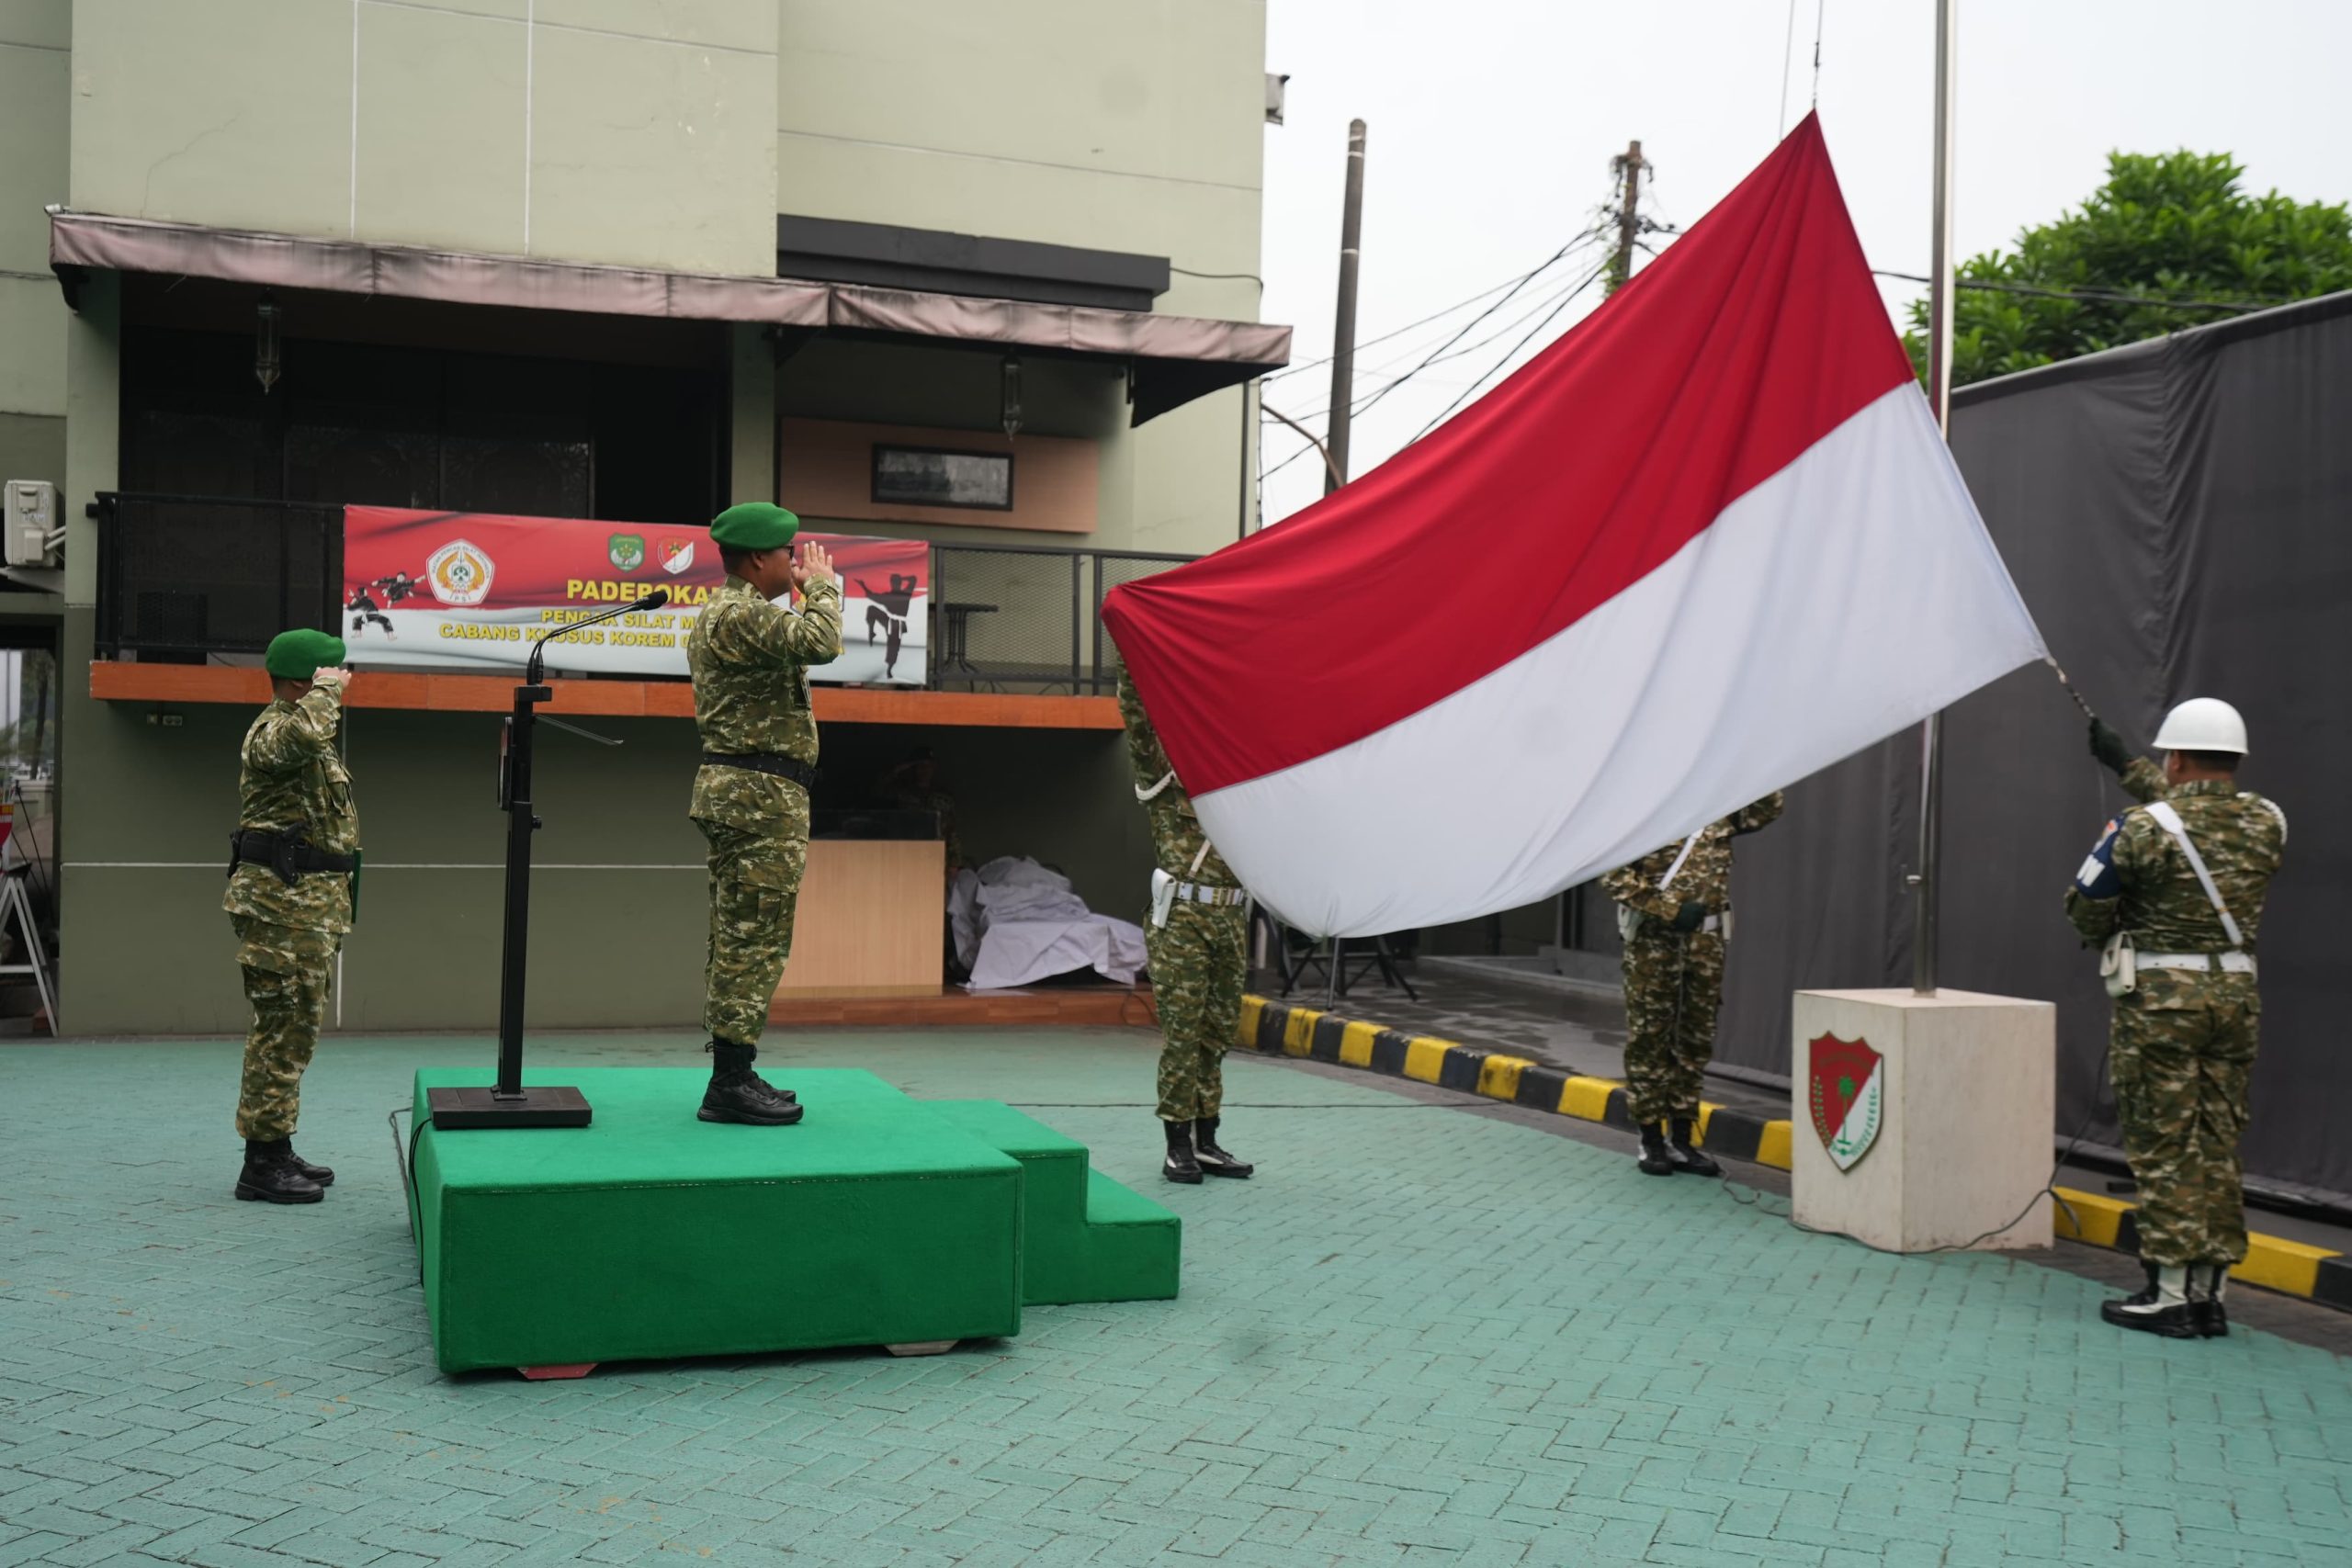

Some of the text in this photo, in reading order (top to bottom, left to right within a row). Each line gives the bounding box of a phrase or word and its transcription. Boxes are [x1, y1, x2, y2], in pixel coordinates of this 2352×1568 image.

[567, 579, 716, 605] PADEPOKA
[623, 613, 675, 629] SILAT
[439, 624, 520, 641] CABANG
[609, 630, 675, 648] KOREM
